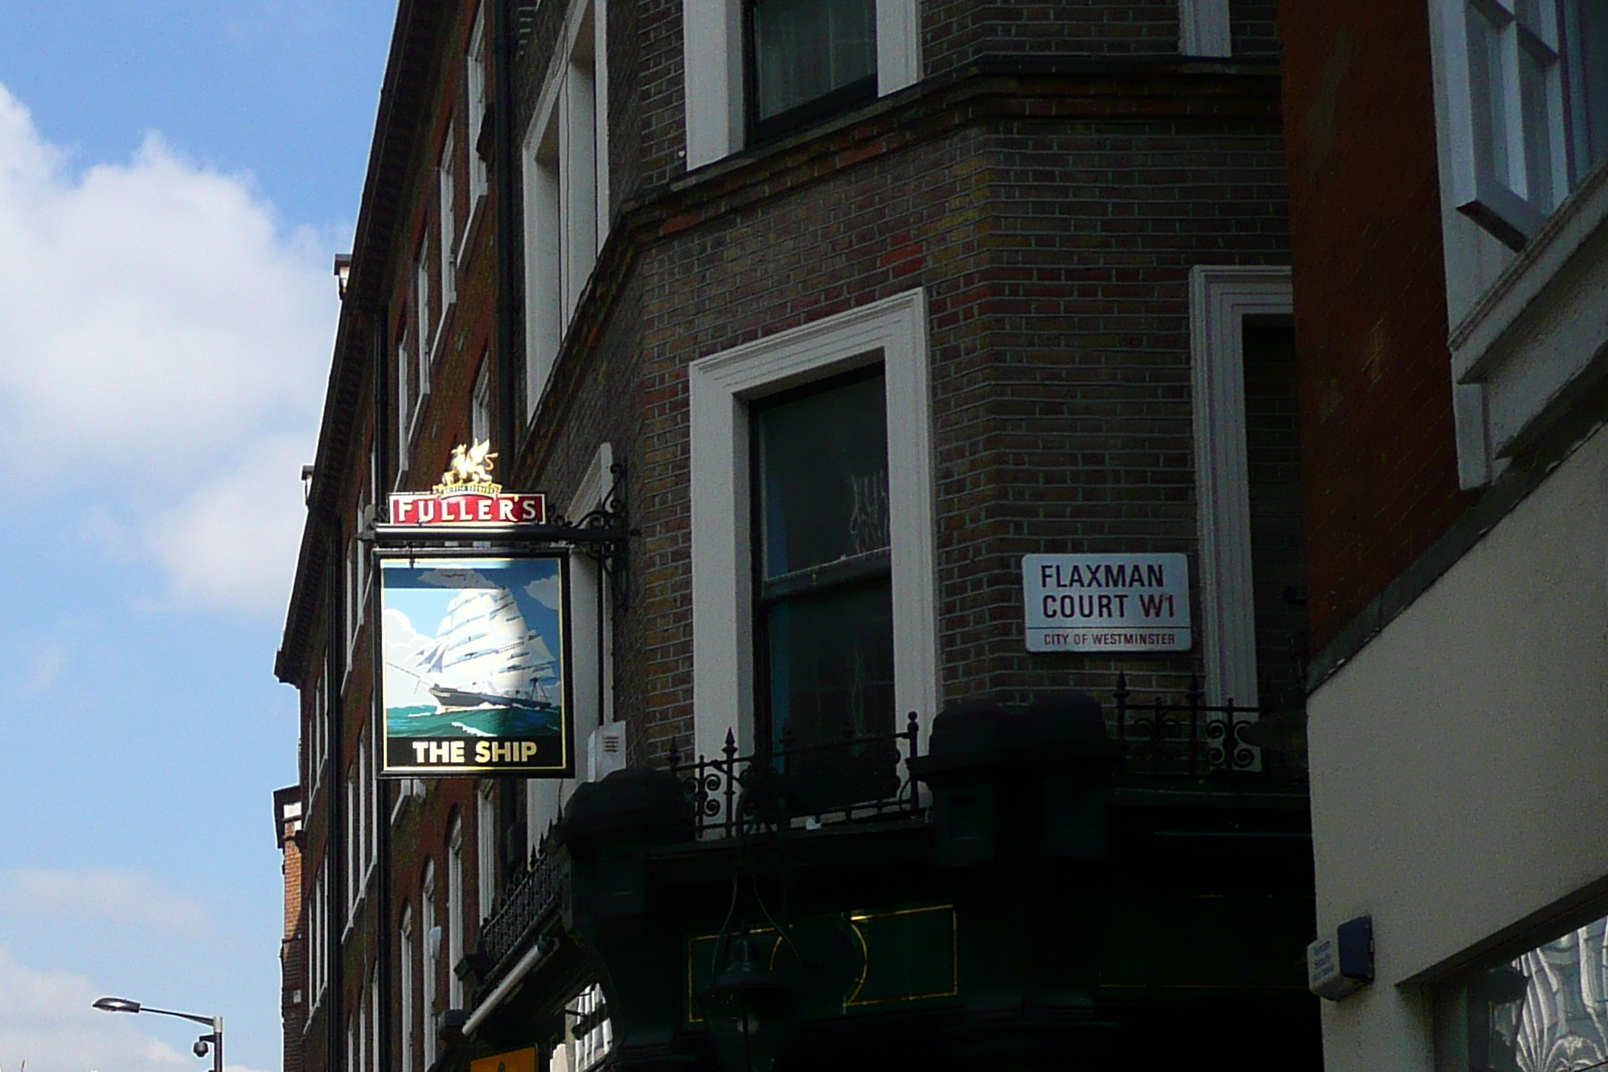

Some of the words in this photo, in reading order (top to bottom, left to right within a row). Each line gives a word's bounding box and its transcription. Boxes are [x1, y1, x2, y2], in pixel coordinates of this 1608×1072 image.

[398, 496, 536, 523] FULLER'S
[1041, 564, 1164, 588] FLAXMAN
[1043, 594, 1129, 618] COURT
[1139, 594, 1175, 618] W1
[1044, 634, 1069, 645] CITY
[1074, 634, 1088, 645] OF
[1092, 633, 1176, 645] WESTMINSTER
[412, 740, 465, 763] THE
[475, 740, 538, 763] SHIP
